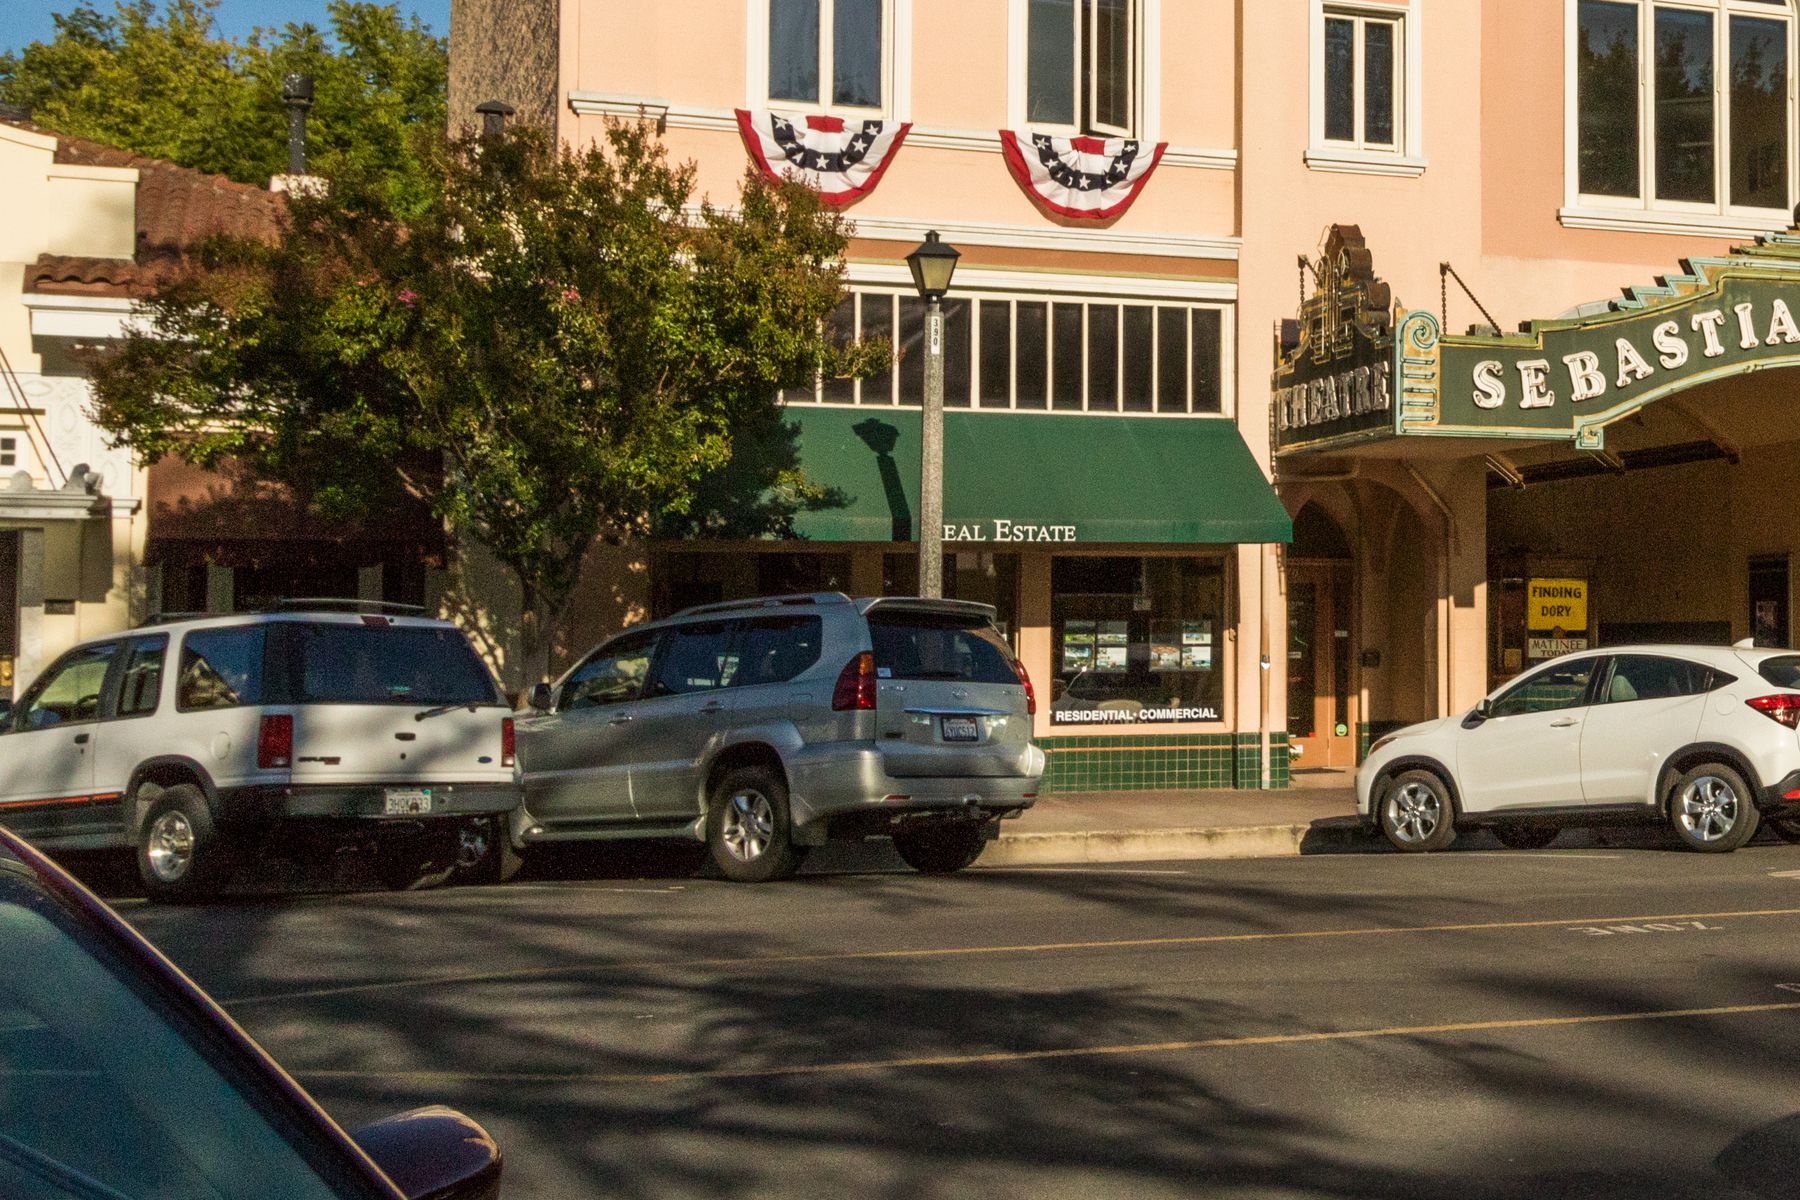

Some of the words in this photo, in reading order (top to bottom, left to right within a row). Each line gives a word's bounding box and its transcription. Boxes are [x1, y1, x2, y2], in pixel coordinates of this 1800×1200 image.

[1277, 361, 1390, 431] THEATRE
[941, 525, 987, 542] EAL
[1532, 586, 1582, 599] FINDING
[1541, 606, 1572, 617] DORY
[1532, 639, 1583, 650] MATINEE
[1055, 709, 1133, 722] RESIDENTIAL
[1139, 707, 1218, 720] COMMERCIAL
